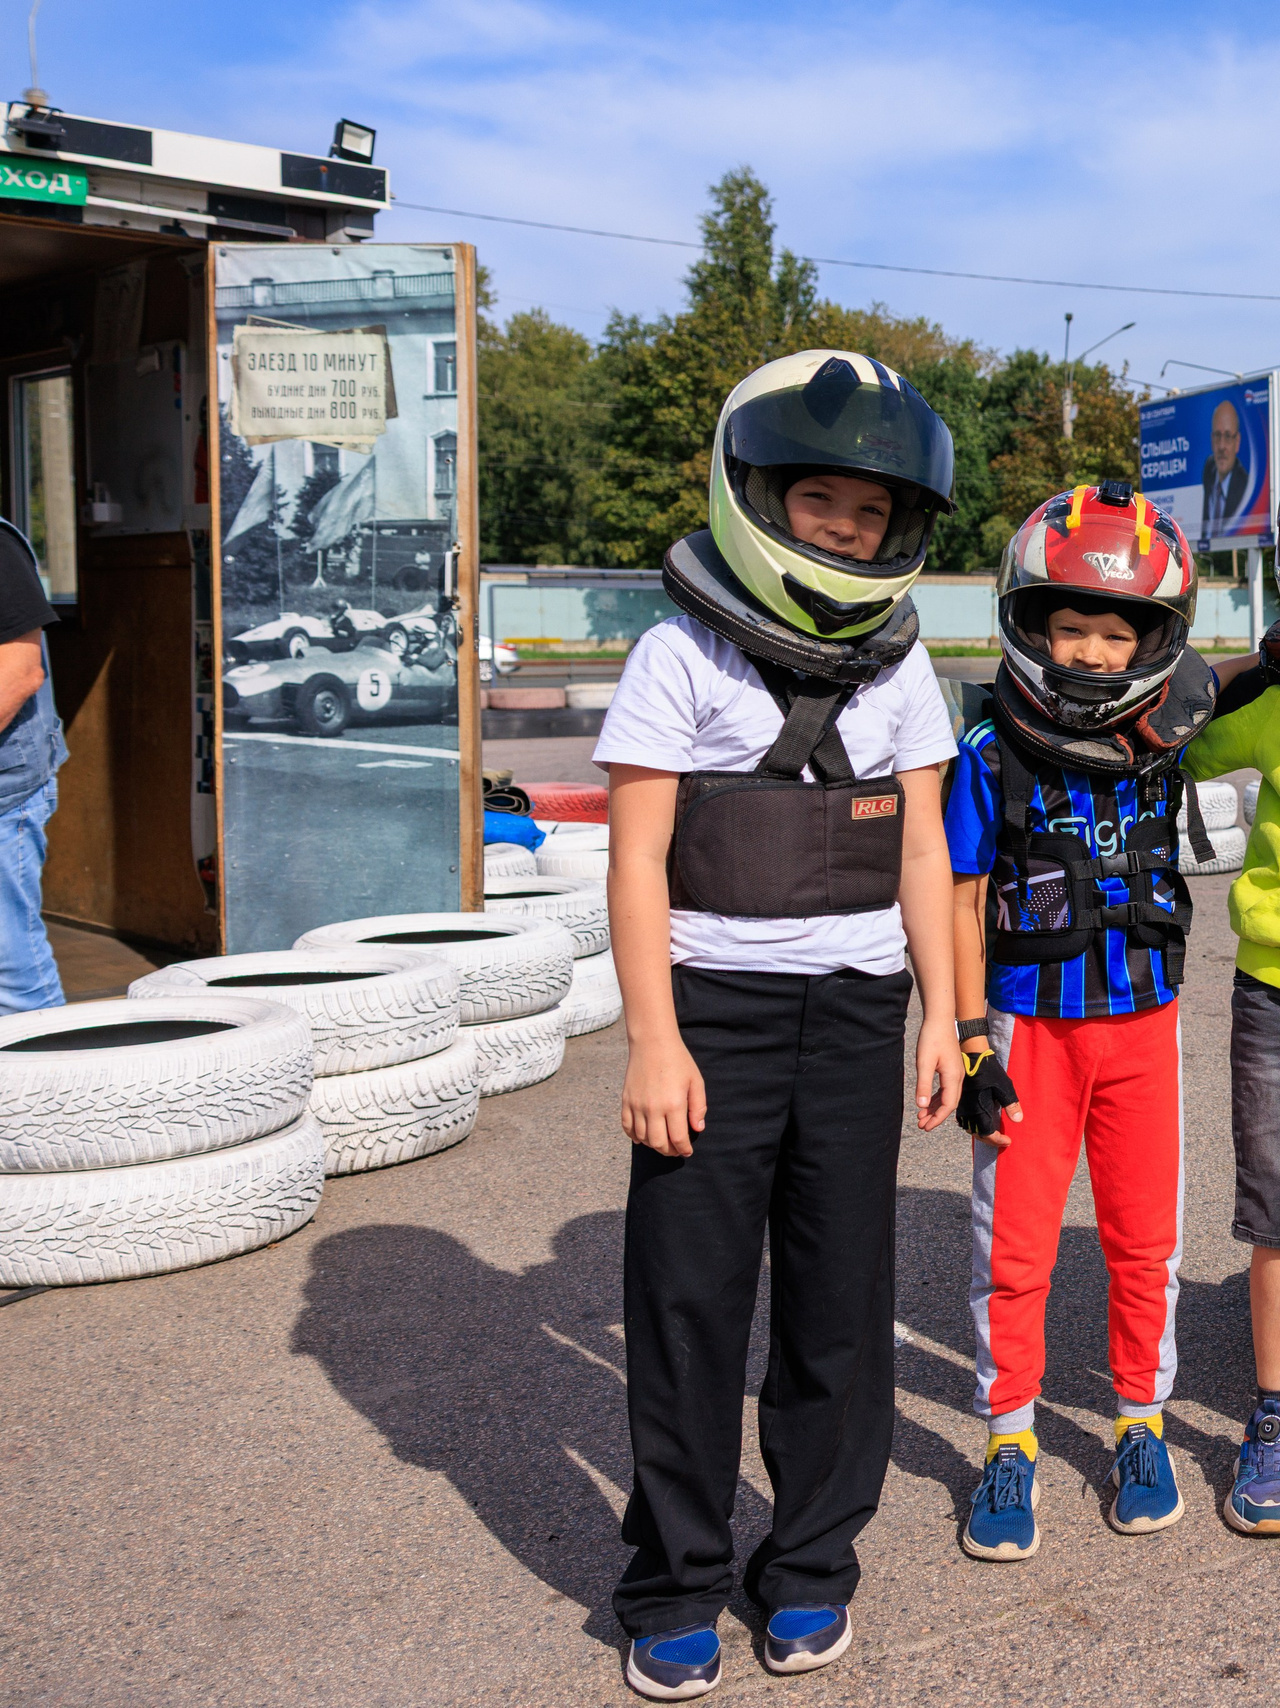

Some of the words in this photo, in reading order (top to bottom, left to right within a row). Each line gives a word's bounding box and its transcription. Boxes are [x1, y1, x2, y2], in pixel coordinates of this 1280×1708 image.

[0, 167, 72, 196] ХОД
[248, 353, 297, 373] ЗАЕЗД
[302, 353, 318, 371] 10
[323, 353, 377, 371] МИНУТ
[331, 379, 356, 397] 700
[330, 401, 356, 419] 800
[1141, 436, 1190, 459] СЛЫШАТЬ
[1141, 458, 1188, 479] СЕРДЦЕМ
[370, 673, 380, 697] 5
[856, 799, 894, 815] RLG
